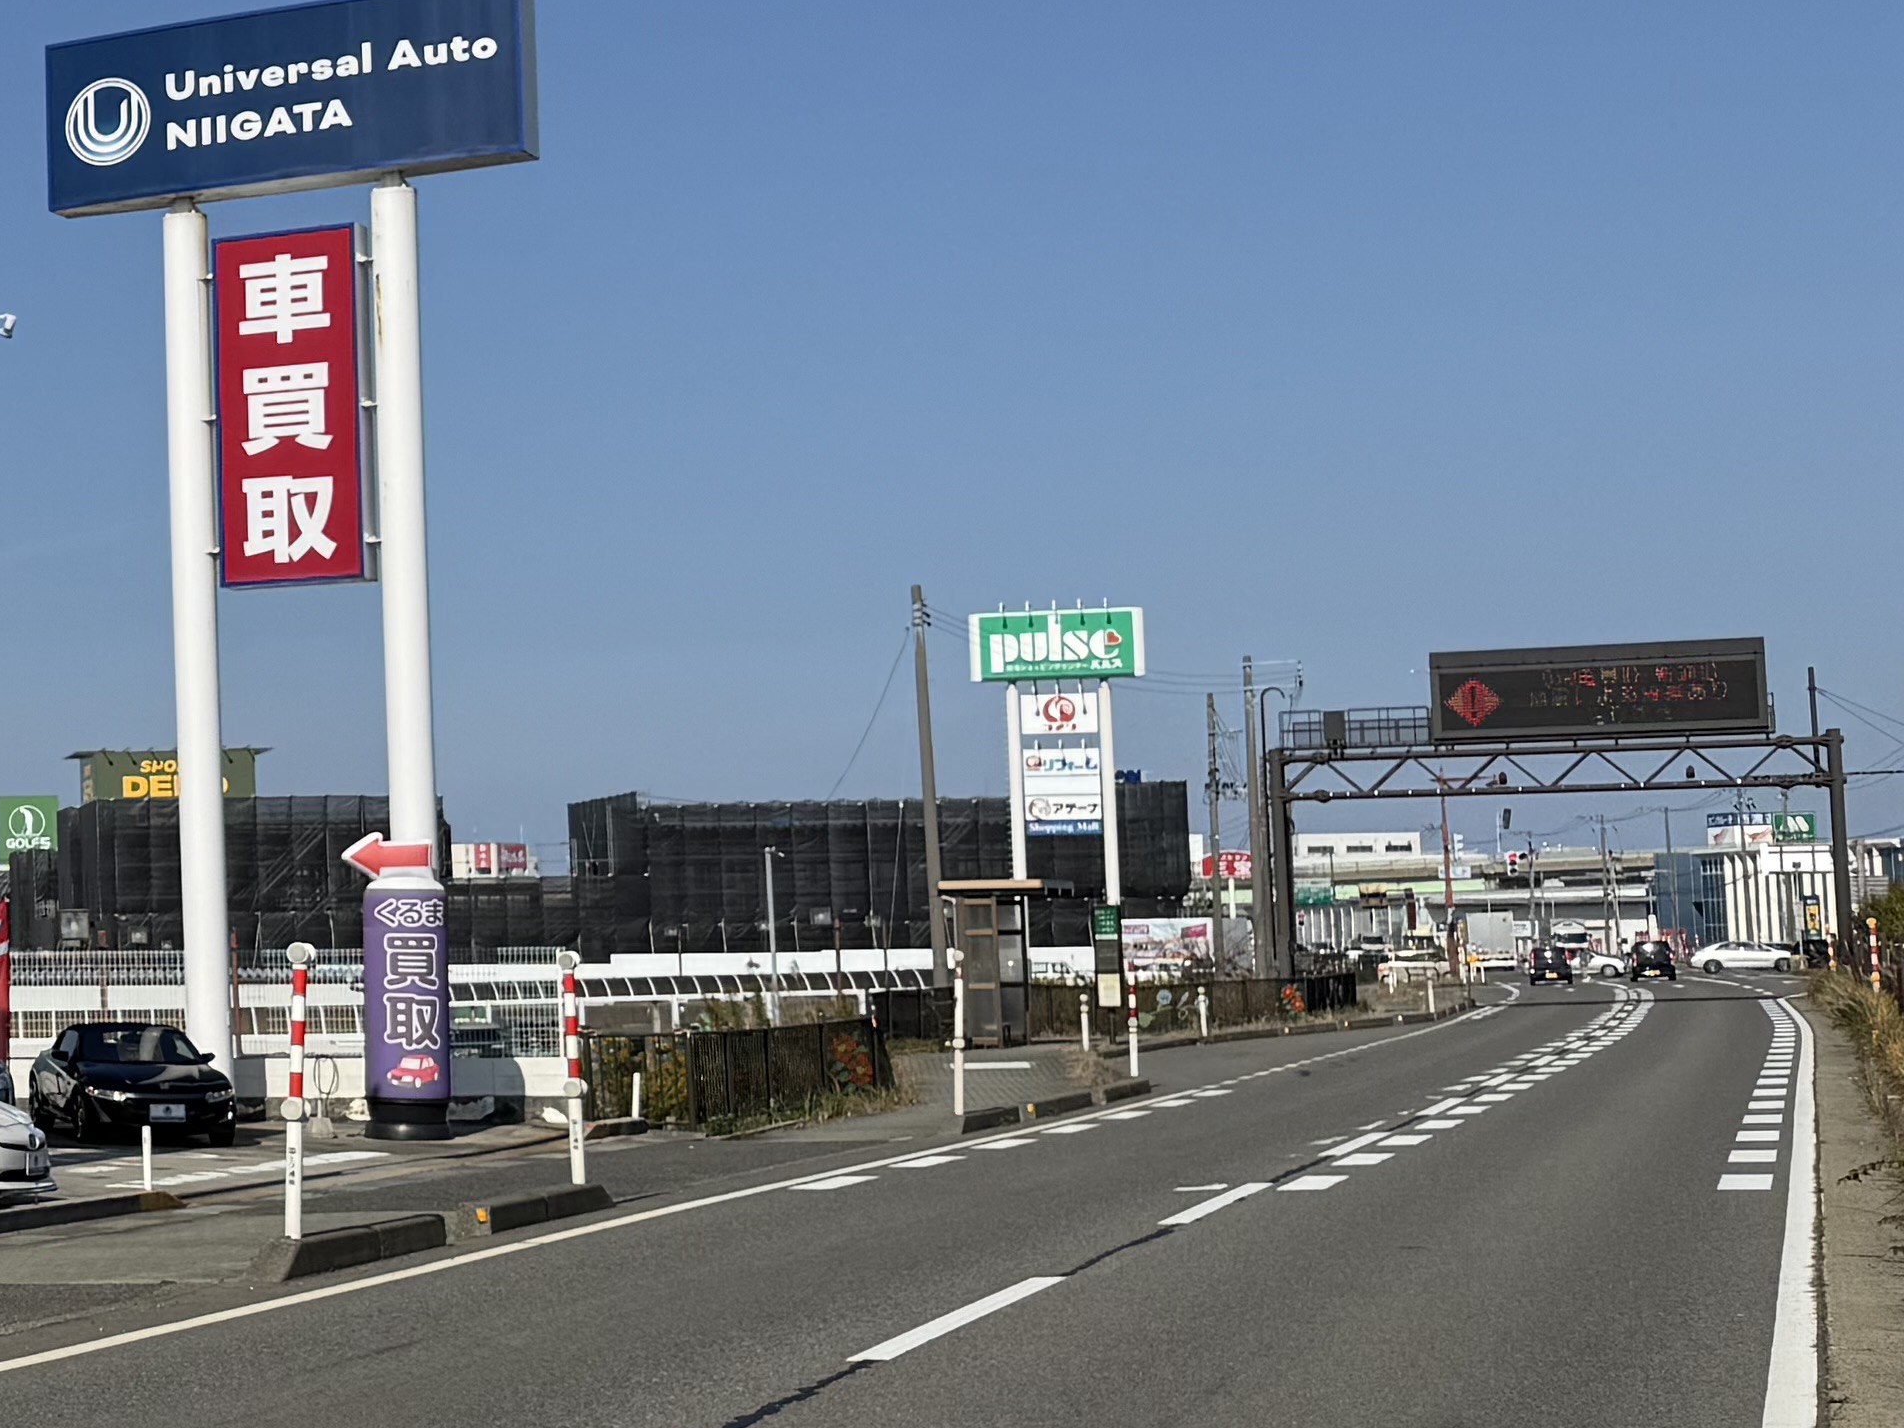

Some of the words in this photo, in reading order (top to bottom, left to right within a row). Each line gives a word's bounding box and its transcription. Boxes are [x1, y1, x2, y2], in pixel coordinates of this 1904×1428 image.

[166, 42, 372, 101] Universal
[388, 36, 497, 70] Auto
[166, 99, 352, 150] NIIGATA
[239, 254, 337, 564] 車買取
[989, 614, 1123, 673] pulse
[140, 759, 178, 773] SPO
[374, 898, 443, 927] くるま
[383, 933, 440, 1050] 買取
